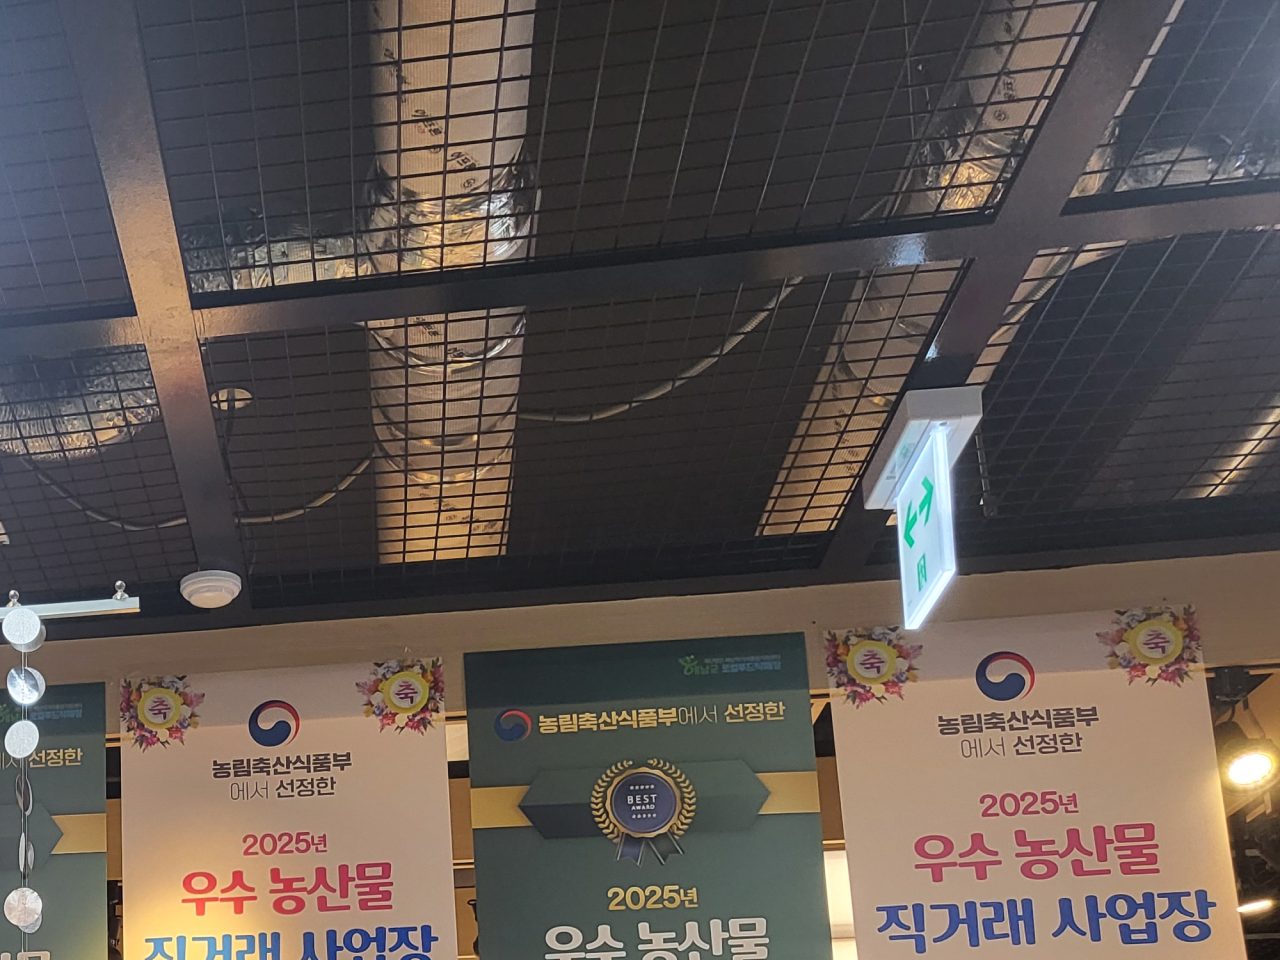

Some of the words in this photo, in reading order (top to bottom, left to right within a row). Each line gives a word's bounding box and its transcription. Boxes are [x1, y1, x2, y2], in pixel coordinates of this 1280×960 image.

[723, 701, 786, 723] 선정한
[937, 706, 1099, 735] 농림축산식품부
[29, 748, 83, 769] 선정한
[960, 737, 1005, 759] 에서
[1013, 733, 1083, 755] 선정한
[212, 752, 352, 779] 농림축산식품부
[229, 780, 269, 801] 에서
[275, 776, 337, 798] 선정한
[627, 794, 657, 804] BEST
[631, 803, 655, 811] AWARD
[979, 791, 1078, 818] 2025년
[242, 831, 328, 857] 2025년
[914, 833, 1001, 883] 우수
[1014, 823, 1160, 880] 농산물
[181, 870, 257, 916] 우수
[269, 862, 394, 915] 농산물
[607, 884, 698, 911] 2025년
[876, 899, 1036, 954] 직거래
[1052, 889, 1216, 944] 사업장
